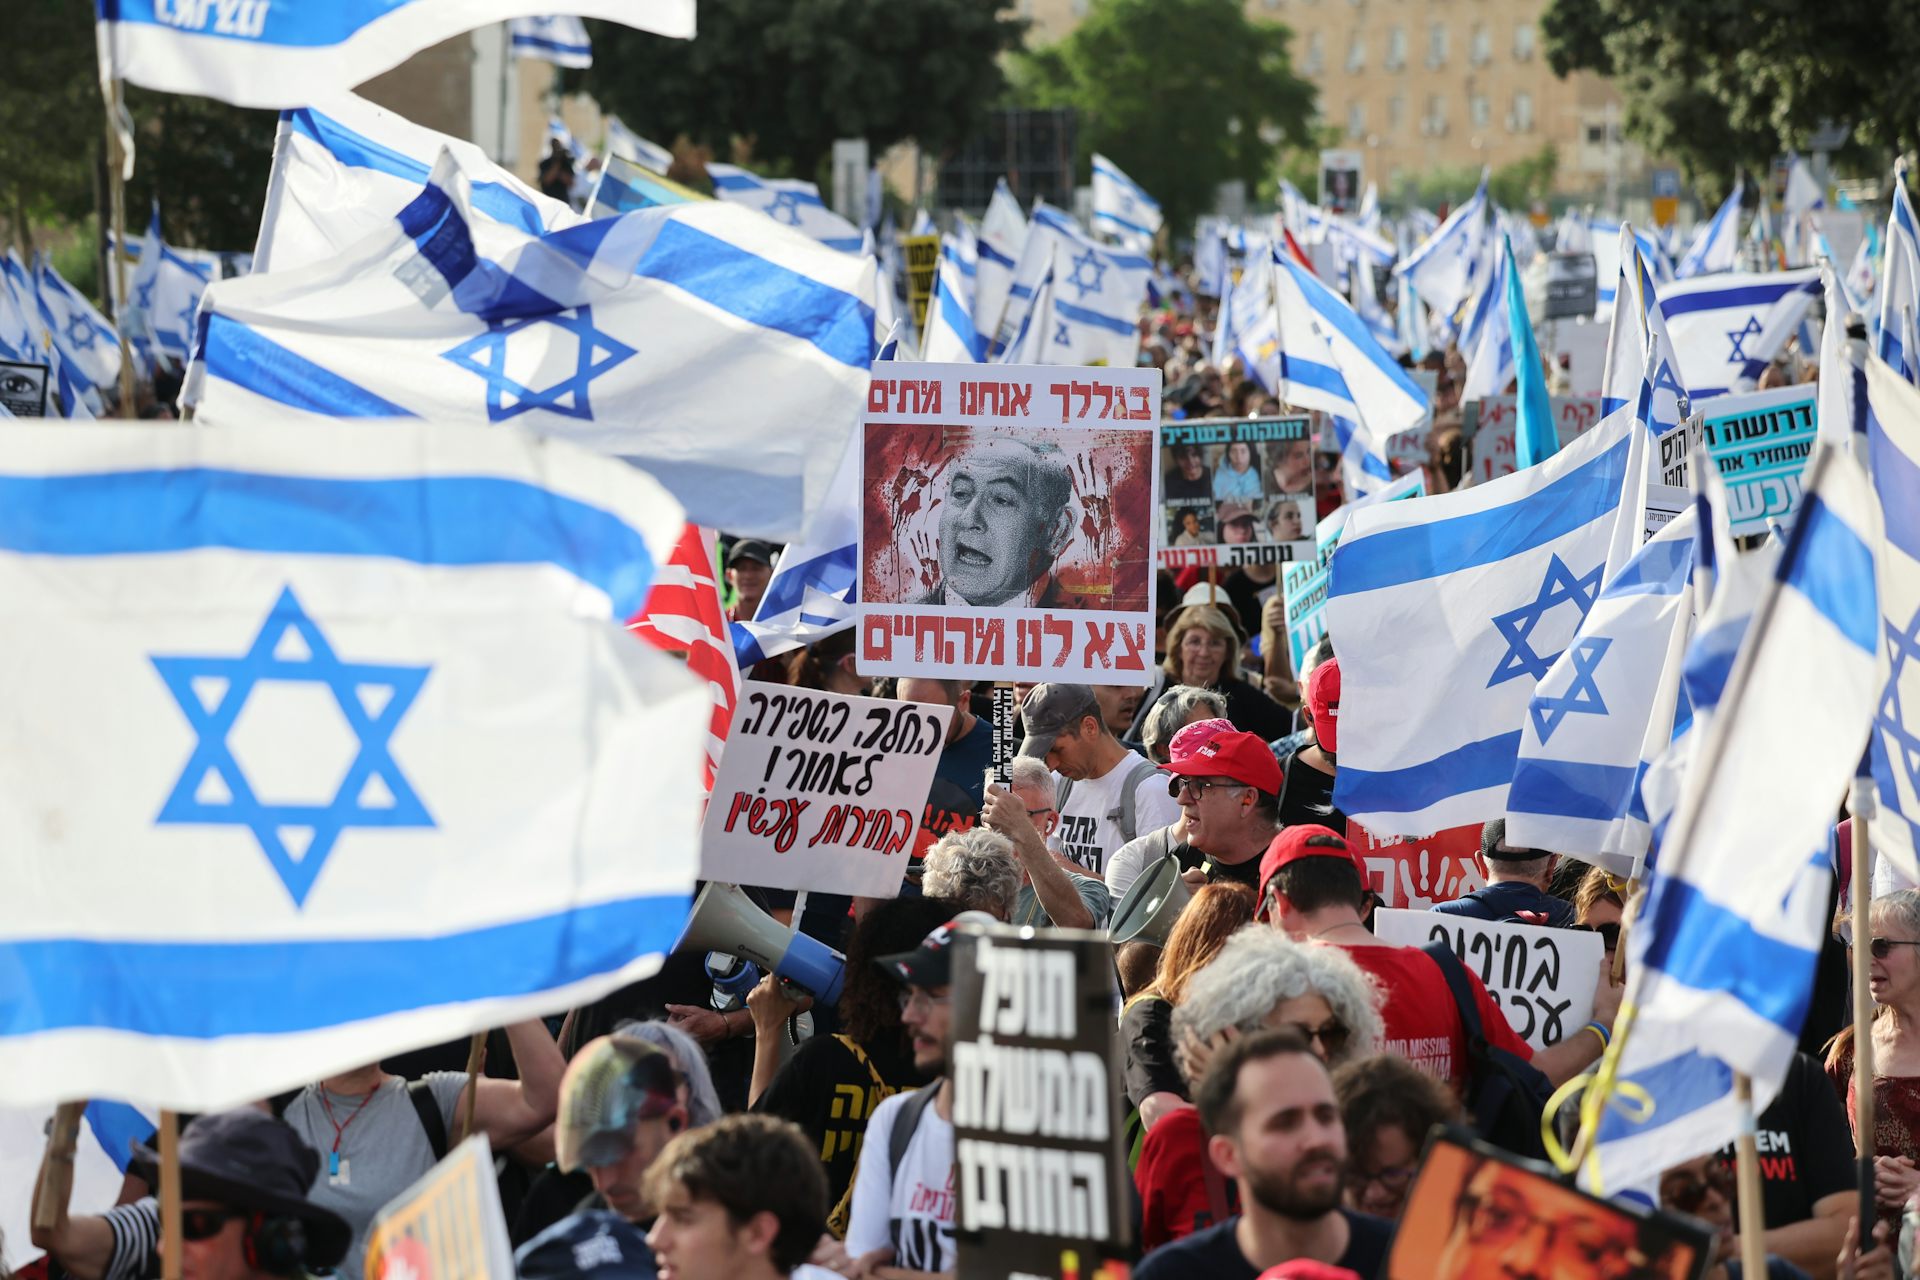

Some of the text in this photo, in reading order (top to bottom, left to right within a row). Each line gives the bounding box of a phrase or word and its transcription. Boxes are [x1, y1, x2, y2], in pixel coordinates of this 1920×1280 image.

[867, 379, 1151, 424] בגללך אנחנו מתים
[1160, 421, 1305, 446] זועקות בשביל
[1723, 405, 1811, 443] דרושה
[1718, 454, 1744, 473] את
[1157, 547, 1217, 569] עכשי
[863, 614, 1146, 671] צא לנו מהחיים
[740, 692, 942, 756] החלה הספירה
[724, 792, 912, 855] בחירות עכשיו
[1060, 815, 1099, 845] אתה
[1410, 1036, 1450, 1058] MISSING
[953, 1034, 1109, 1142] ממשלת
